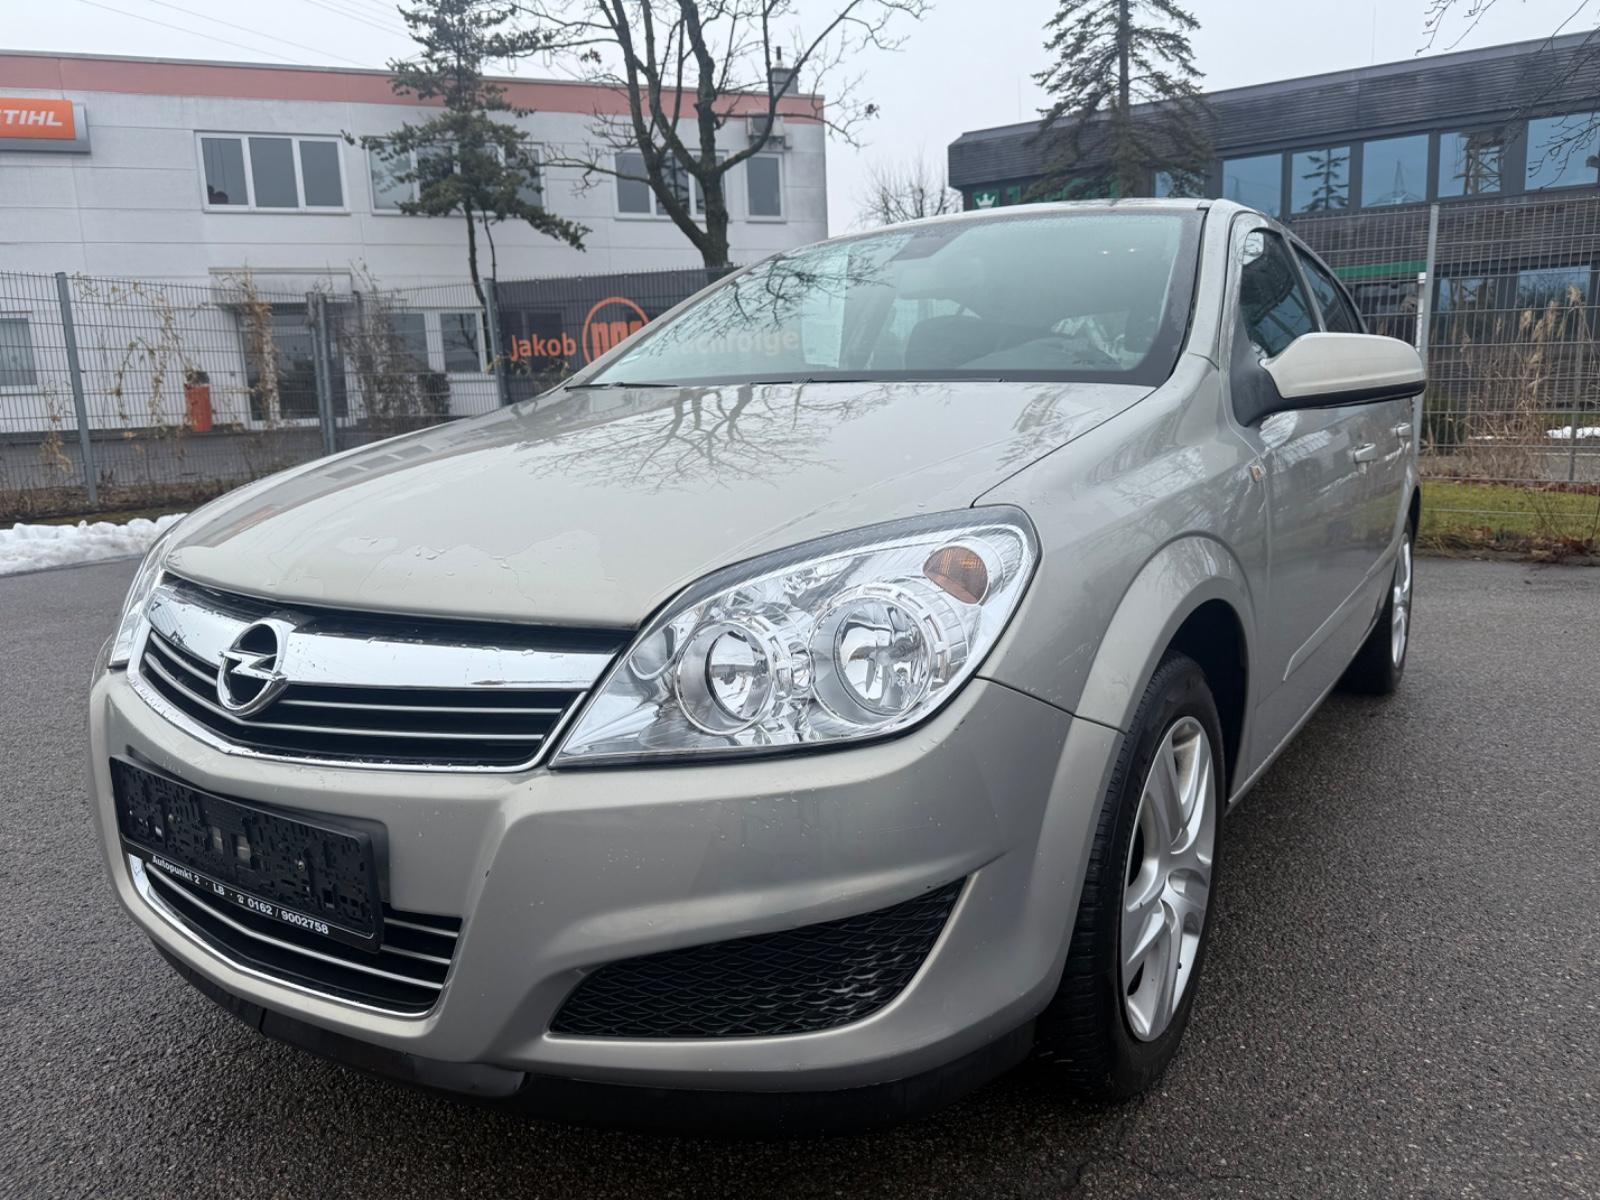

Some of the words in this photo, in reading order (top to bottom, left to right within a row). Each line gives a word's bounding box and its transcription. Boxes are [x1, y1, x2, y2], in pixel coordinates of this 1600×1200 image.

[0, 109, 63, 126] TIHL
[511, 332, 577, 361] Jakob
[152, 855, 193, 881] Autopunkt
[247, 898, 273, 915] 0162
[281, 910, 329, 935] 9002758
